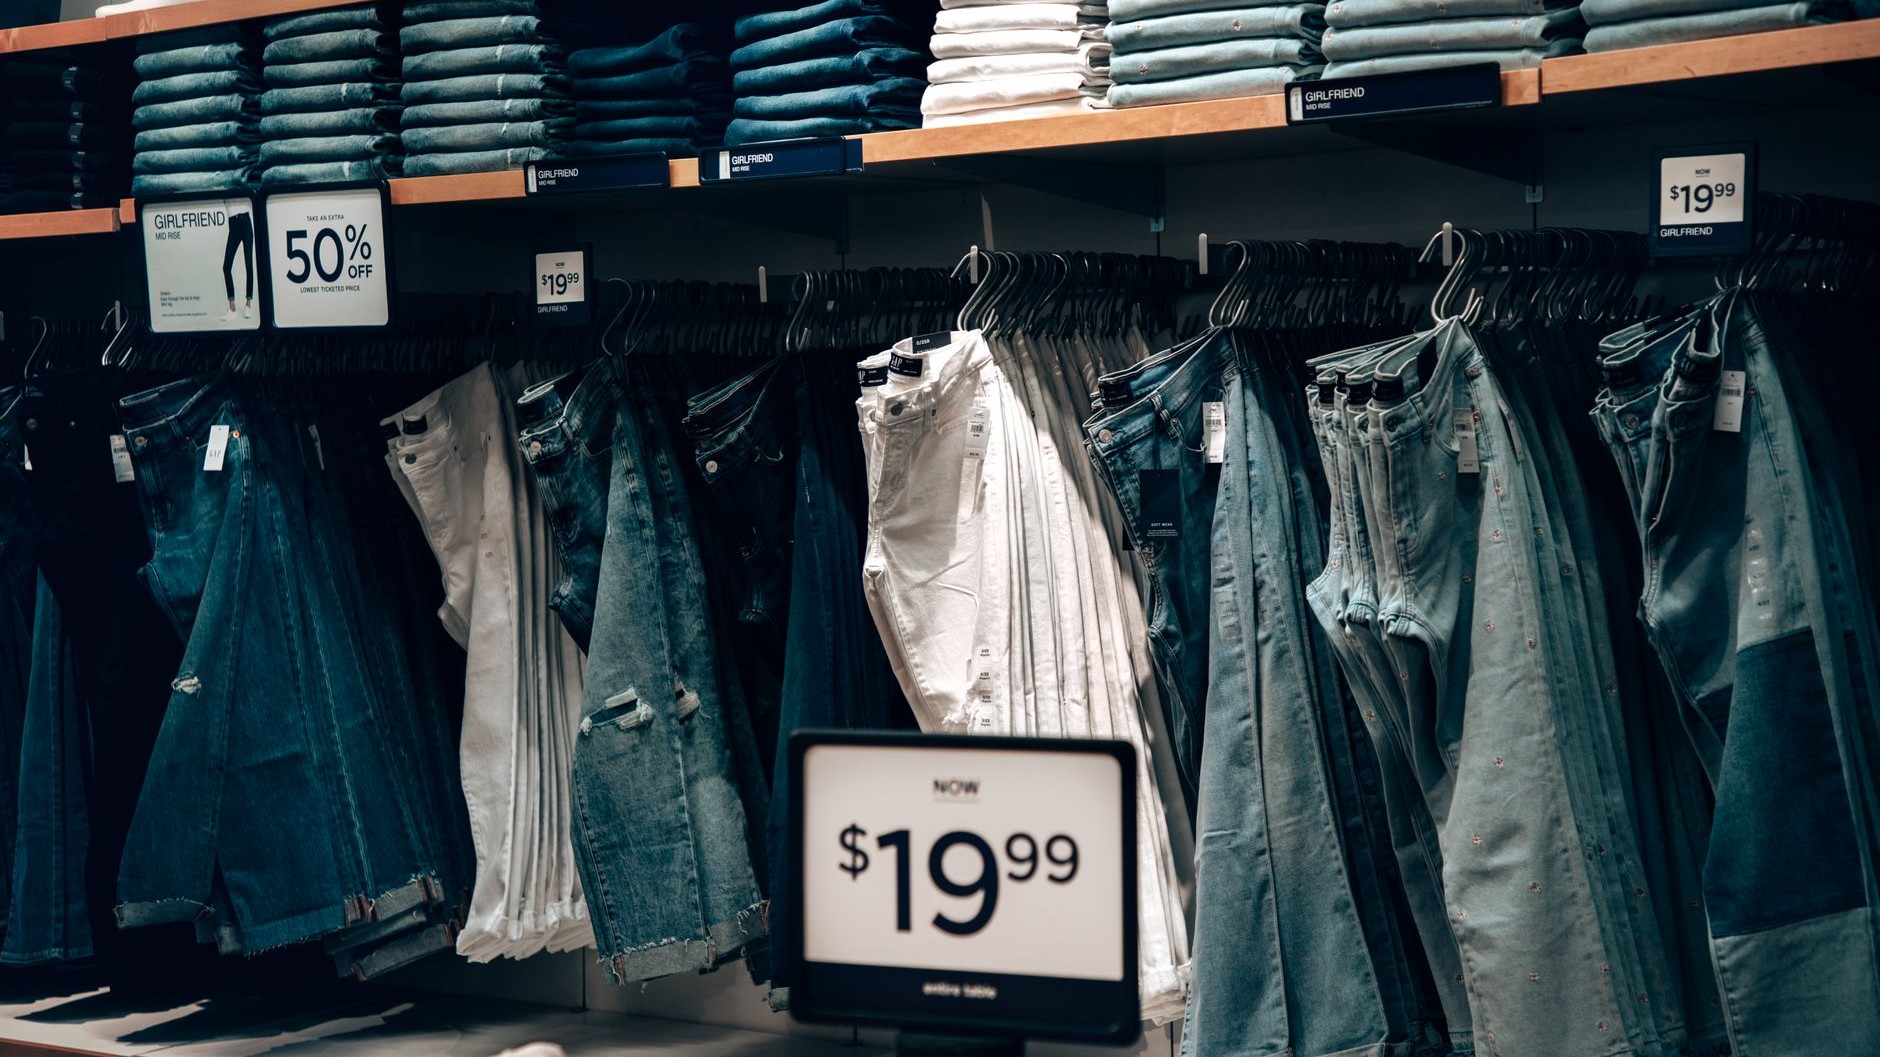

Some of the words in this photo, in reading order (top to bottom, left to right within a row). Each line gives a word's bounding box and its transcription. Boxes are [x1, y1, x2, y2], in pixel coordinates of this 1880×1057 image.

[1305, 87, 1365, 102] GIRLFRIEND
[731, 153, 774, 165] GIRLFRIEND
[538, 168, 579, 179] GIRLFRIEND
[154, 211, 226, 230] GIRLFRIEND
[155, 232, 167, 240] MID
[167, 231, 181, 240] RISE
[1660, 226, 1713, 237] GIRLFRIEND
[286, 223, 372, 284] 50%
[348, 264, 373, 279] OFF
[537, 305, 568, 313] GIRLFRIEND
[932, 779, 981, 797] NOW
[922, 981, 961, 997] entire
[962, 983, 997, 1000] table
